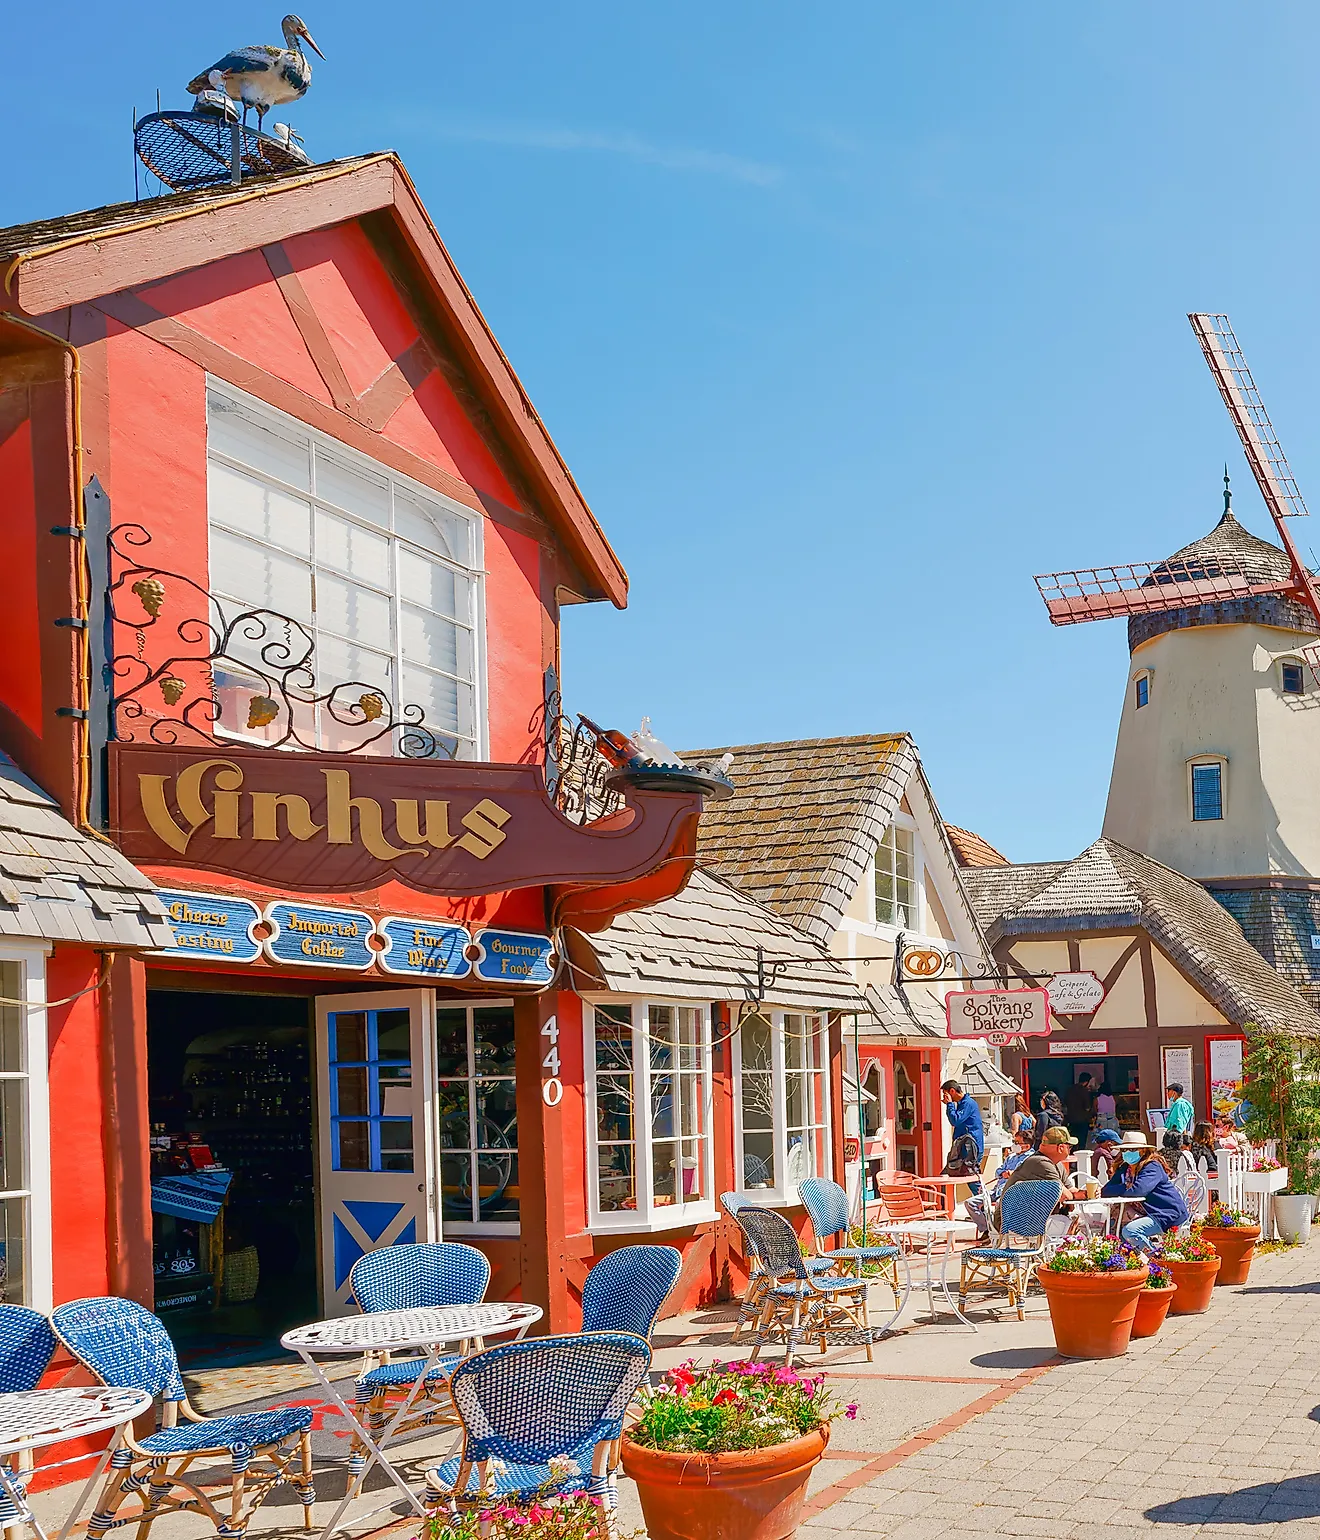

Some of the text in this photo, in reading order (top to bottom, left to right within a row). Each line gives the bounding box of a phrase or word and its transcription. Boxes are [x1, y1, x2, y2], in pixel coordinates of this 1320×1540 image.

[137, 758, 512, 861] Vinhus
[169, 902, 229, 926] Cheese
[288, 911, 359, 937] Imported
[172, 926, 234, 954] asting
[301, 938, 345, 958] Coffee
[413, 928, 444, 949] Fine
[491, 938, 542, 957] Gourmet
[407, 949, 449, 969] Wines
[501, 958, 533, 976] Foods
[990, 994, 1006, 1002] The
[1074, 986, 1101, 1000] Gelato
[963, 997, 1034, 1020] Solvang
[972, 1016, 1025, 1032] Bakery
[540, 1014, 563, 1106] 440
[170, 1257, 196, 1272] 805
[156, 1294, 197, 1308] HOMEGROWN
